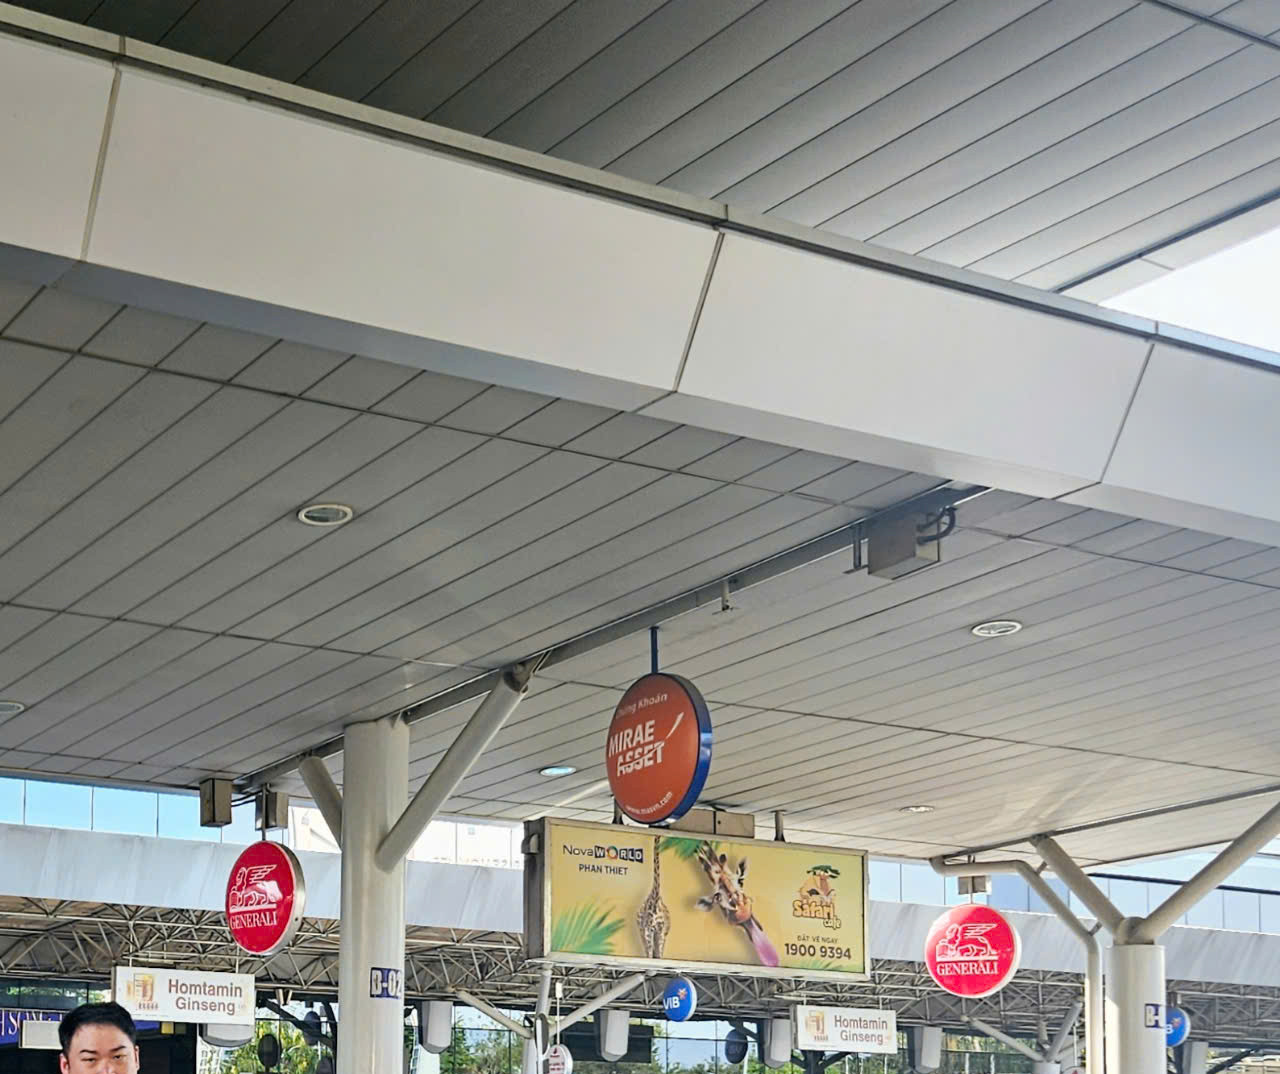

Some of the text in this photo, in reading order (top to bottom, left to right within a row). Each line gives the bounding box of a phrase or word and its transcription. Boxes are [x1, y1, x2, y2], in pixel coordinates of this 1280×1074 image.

[608, 720, 655, 758] MIRAE
[617, 741, 665, 777] ASSET
[579, 864, 628, 876] PHAN THIET
[792, 899, 835, 919] Safari
[230, 911, 277, 930] GENERALI
[785, 943, 851, 960] 1900 9394
[937, 962, 998, 976] GENERALI
[168, 979, 242, 998] Homtamin
[176, 997, 235, 1015] Ginseng
[663, 996, 680, 1010] VIB
[834, 1015, 888, 1030] Homtamin
[840, 1030, 883, 1045] Ginseng
